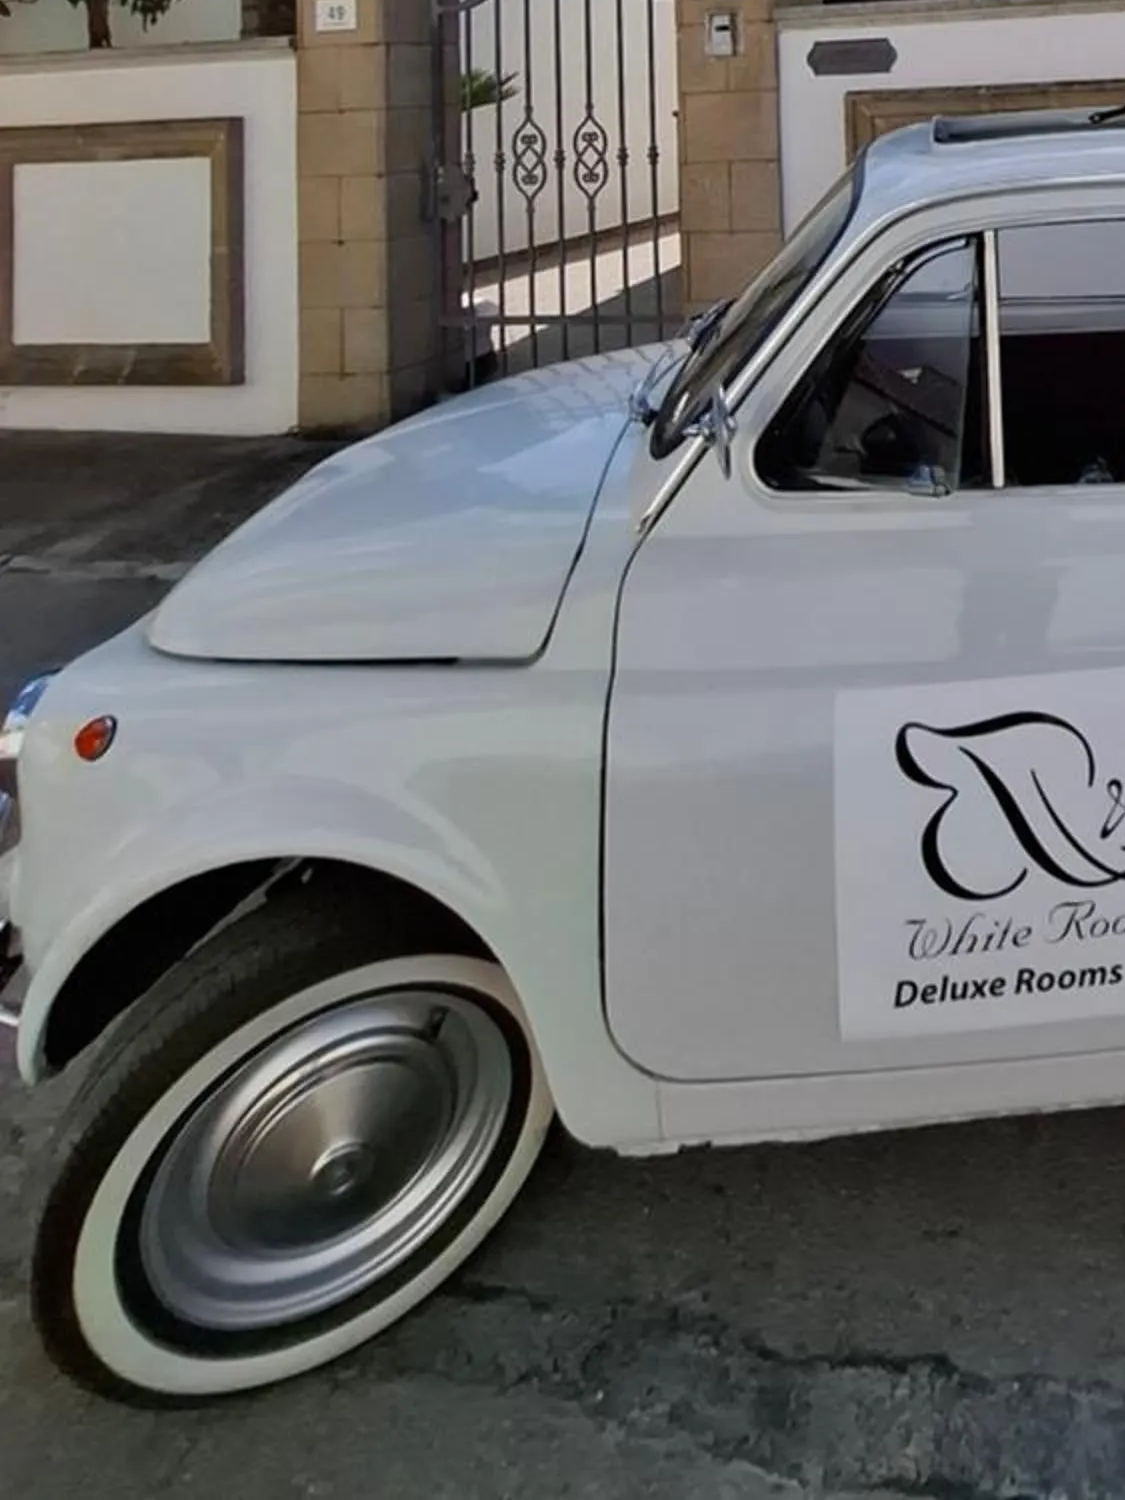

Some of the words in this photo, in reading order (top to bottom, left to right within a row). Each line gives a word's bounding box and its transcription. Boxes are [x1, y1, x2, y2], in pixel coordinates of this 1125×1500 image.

[904, 912, 1032, 962] White
[894, 973, 1007, 1009] Deluxe
[1014, 963, 1124, 995] Rooms
